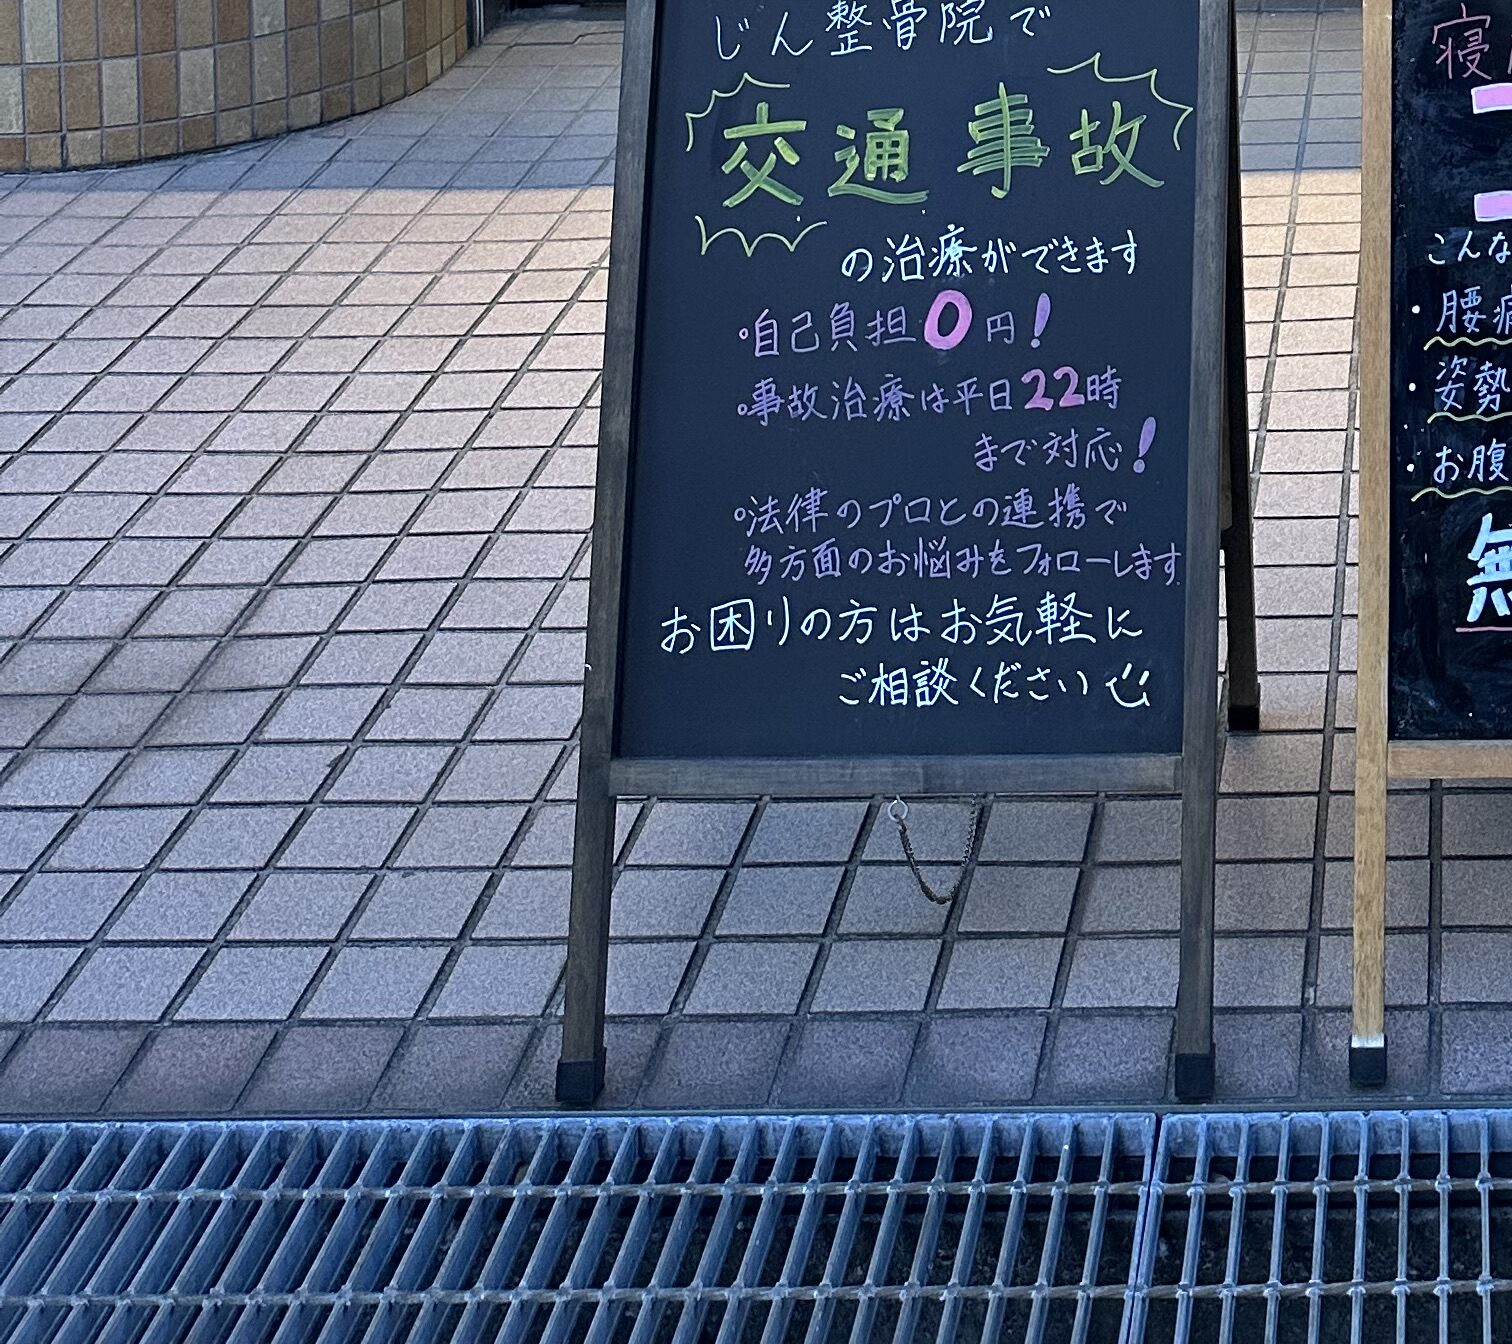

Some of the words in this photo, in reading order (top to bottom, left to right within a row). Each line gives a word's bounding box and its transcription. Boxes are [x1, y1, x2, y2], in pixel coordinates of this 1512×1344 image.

[721, 81, 1166, 208] 交通事故
[840, 223, 1140, 283] の治療ができます
[974, 415, 1157, 475] まで対応!
[746, 483, 1128, 537] 法律のプロとの連携で
[744, 536, 1184, 585] 多方面のお悩みをフォローします
[660, 591, 1145, 654] お困りの方はお気軽に
[838, 658, 1089, 707] ご相談ください
